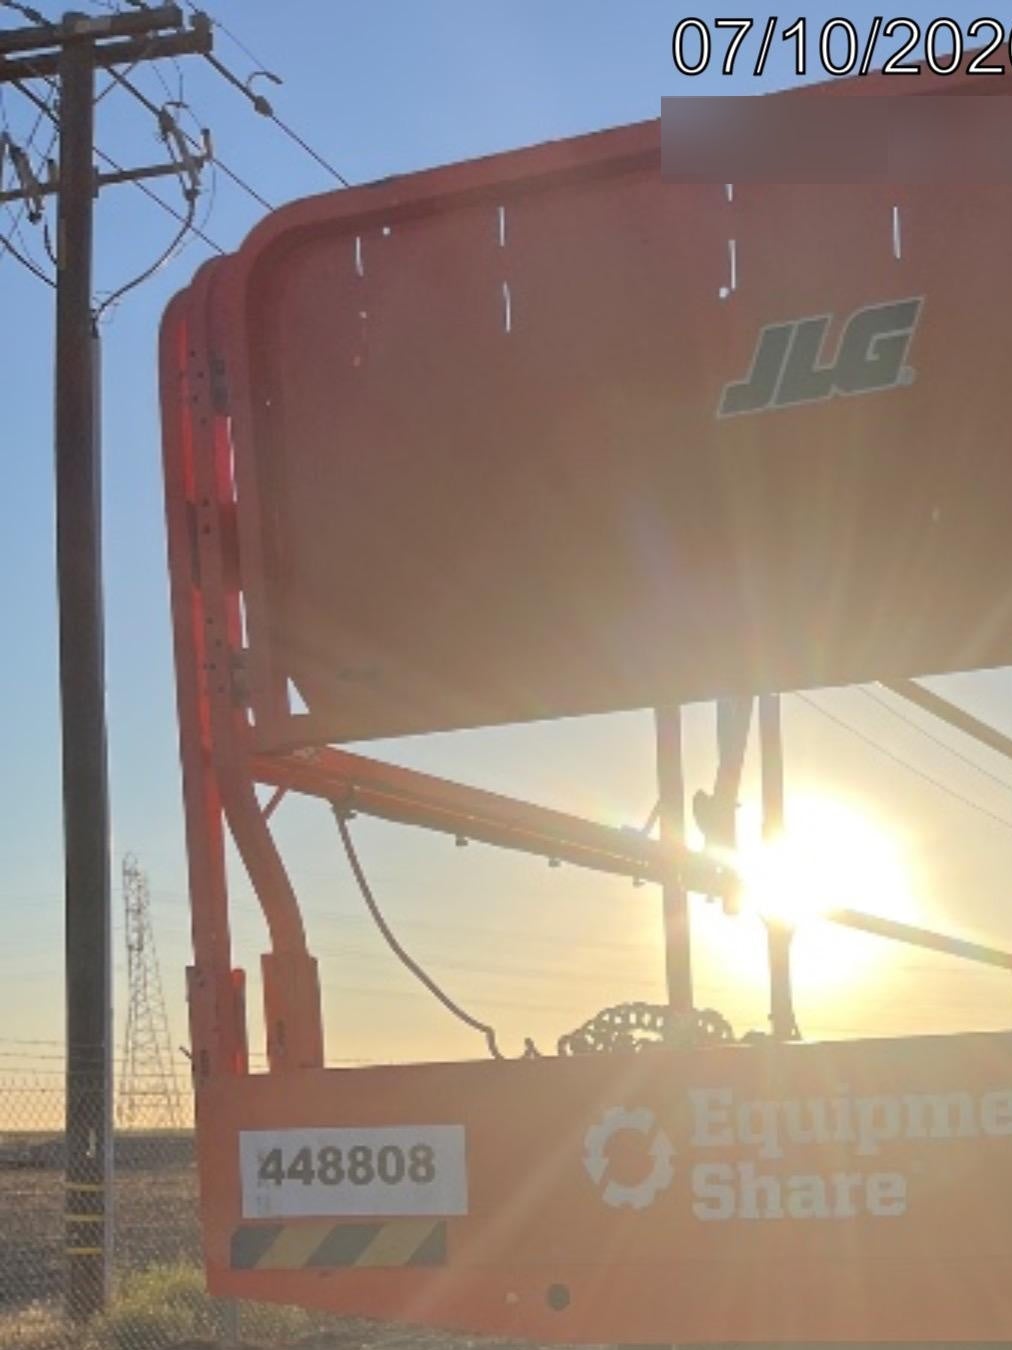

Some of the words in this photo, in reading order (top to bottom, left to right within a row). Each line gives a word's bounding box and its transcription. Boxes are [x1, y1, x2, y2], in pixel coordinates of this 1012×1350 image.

[717, 296, 923, 418] JLG
[258, 1145, 436, 1187] 448808
[691, 1161, 908, 1221] Share
